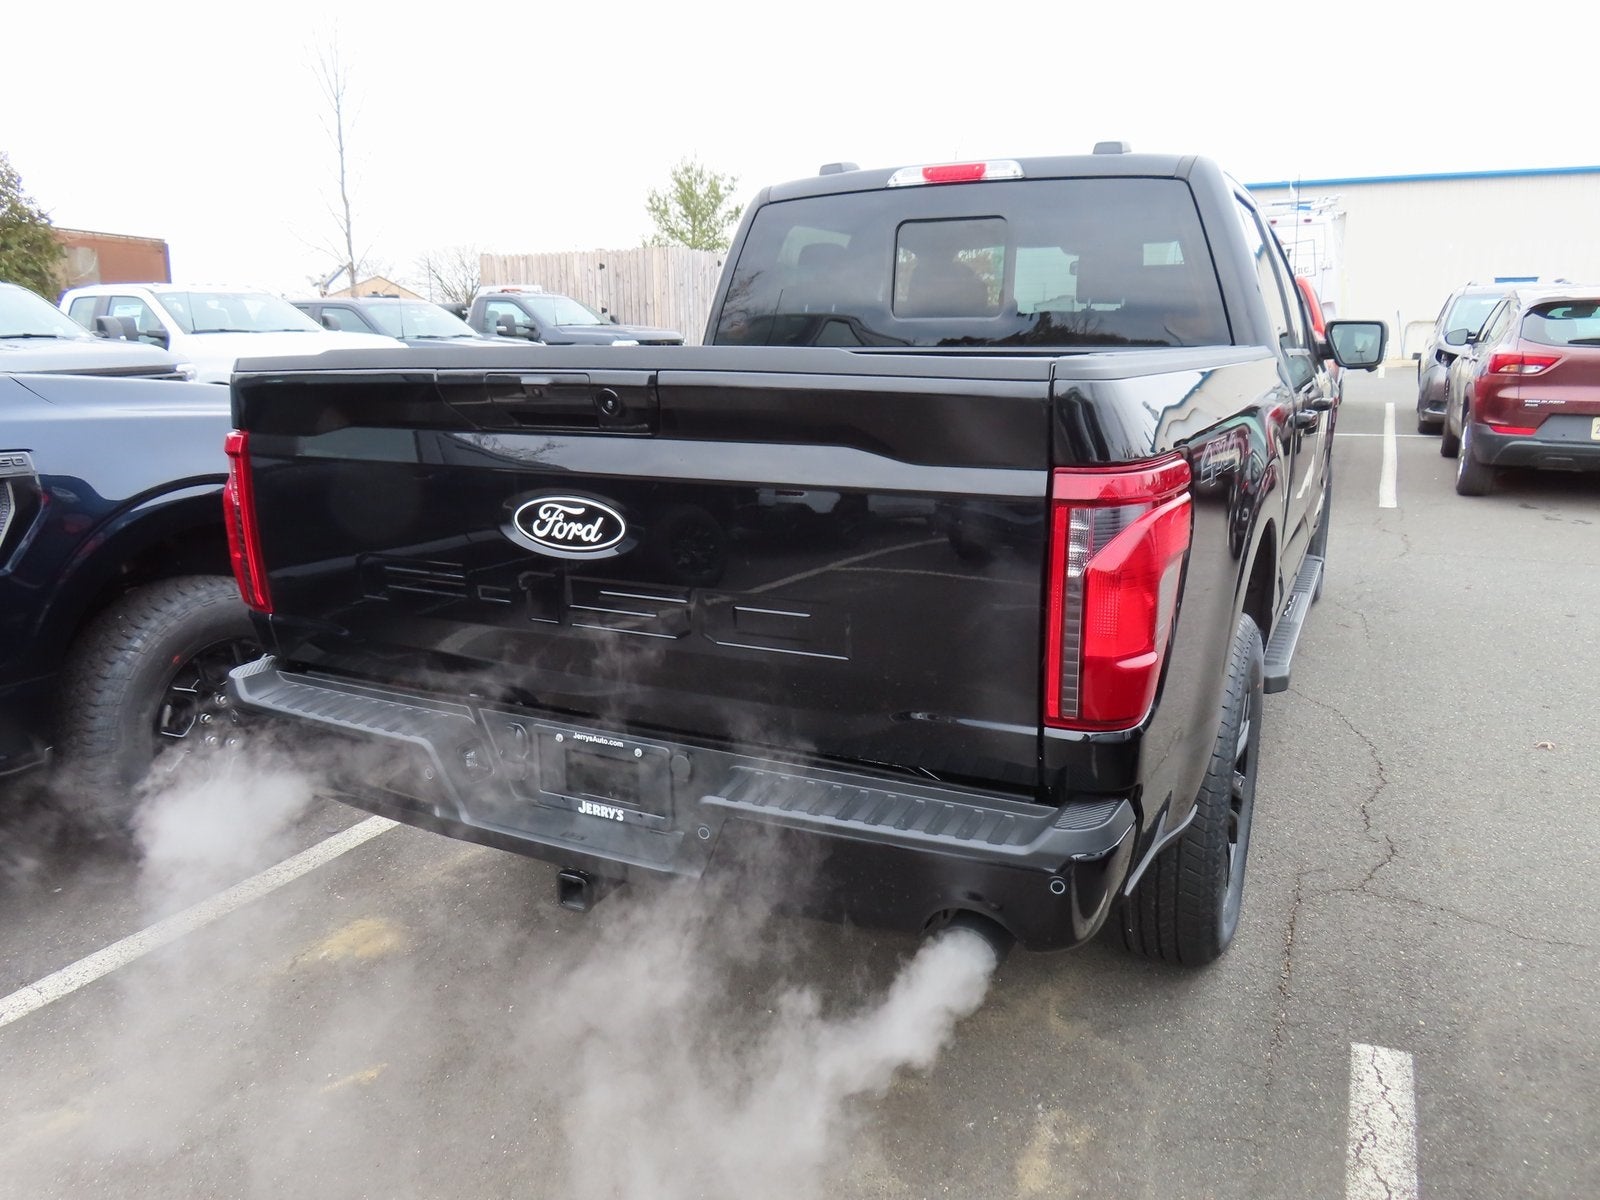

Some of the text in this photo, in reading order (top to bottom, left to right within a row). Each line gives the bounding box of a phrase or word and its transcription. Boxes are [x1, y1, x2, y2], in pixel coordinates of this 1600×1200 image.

[532, 503, 604, 542] Ford
[573, 732, 624, 748] JerrysAuto.com
[578, 801, 624, 821] JERRY'S
